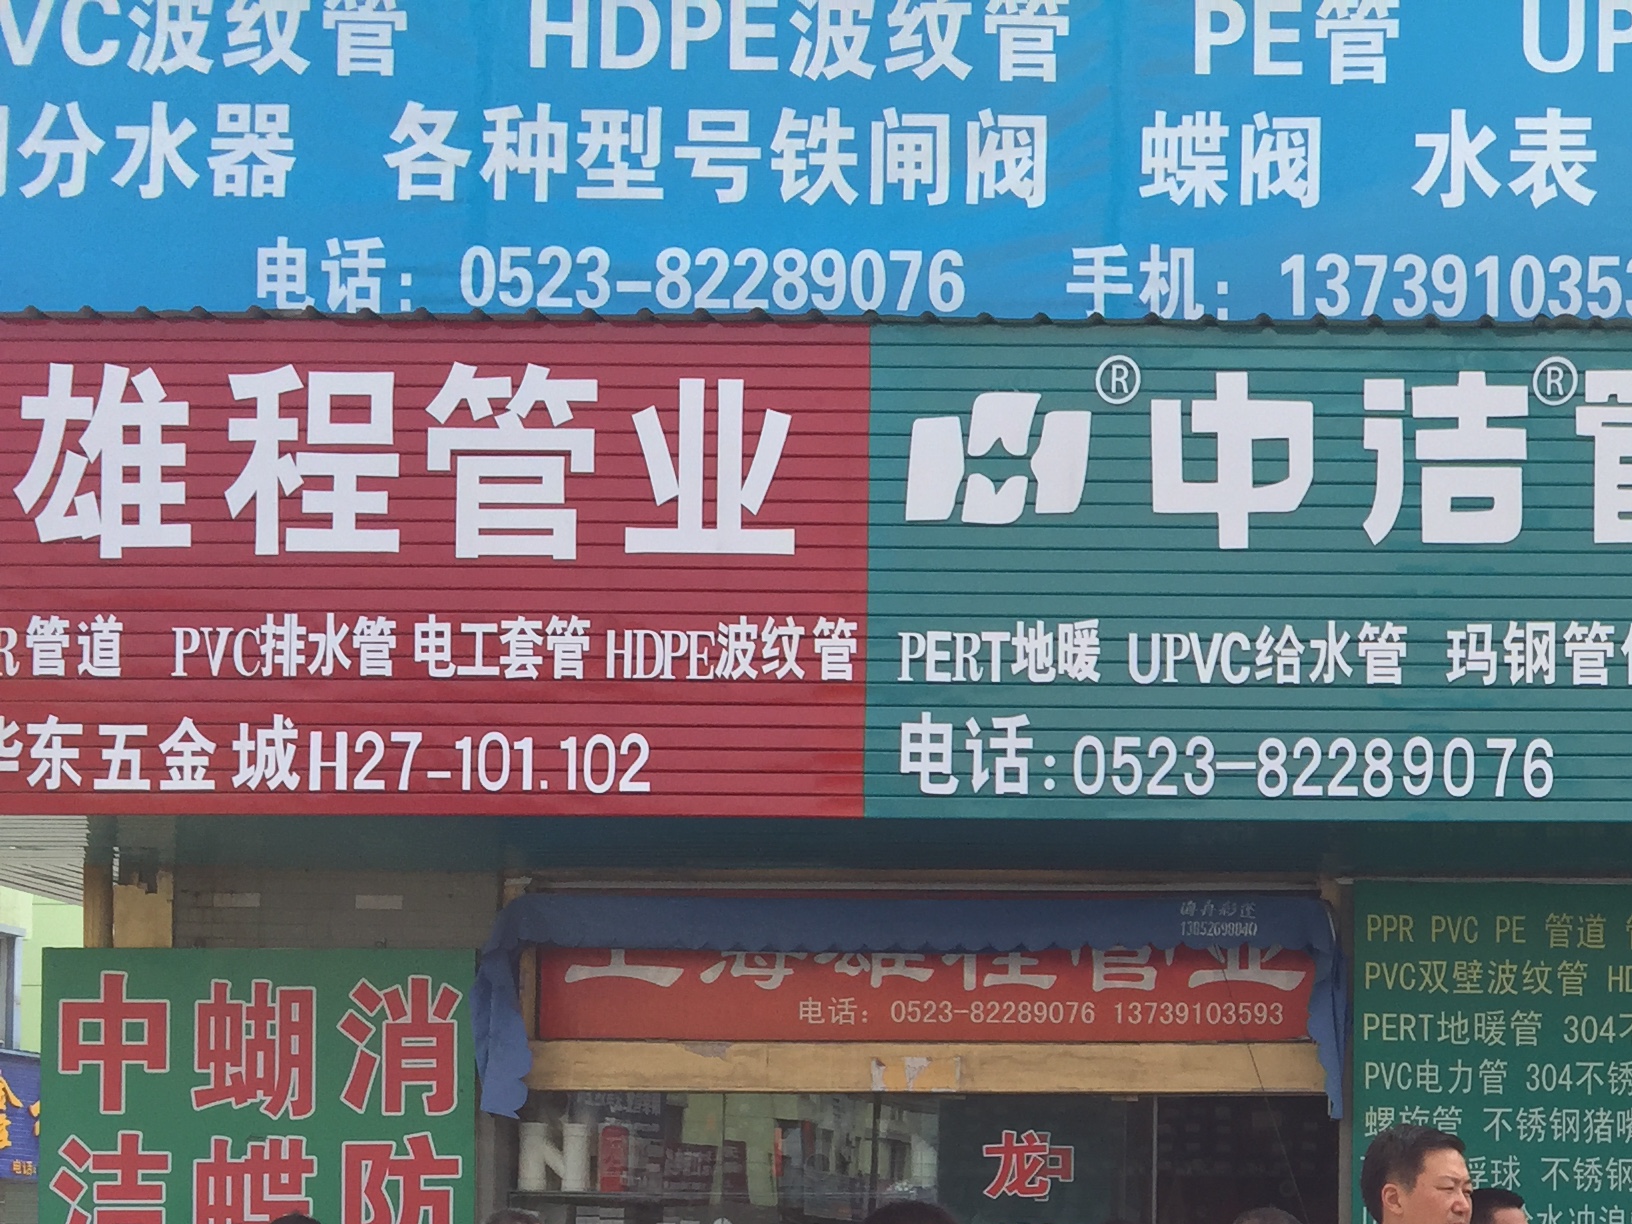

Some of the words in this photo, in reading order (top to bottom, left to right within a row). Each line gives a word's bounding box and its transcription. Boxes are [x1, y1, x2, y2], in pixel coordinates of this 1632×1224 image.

[0, 101, 297, 199] 分水器
[383, 101, 1048, 208] 各种型号铁闸阀
[1140, 111, 1320, 208] 蝶阀
[1412, 108, 1596, 208] 水表
[460, 246, 966, 312] 0523-82289076
[14, 362, 794, 559] 雄程管业
[172, 613, 396, 676] PVC排水管
[415, 614, 590, 679] 电工套管
[607, 616, 857, 680] HDPE波纹管
[898, 619, 1100, 682] PERT地暖
[1129, 621, 1407, 684] UPVC给水管
[1366, 914, 1414, 943] PPR
[1431, 915, 1479, 944] PVC
[1495, 915, 1527, 944] PE
[1545, 914, 1607, 950] 管道
[1364, 959, 1588, 997] PVC双壁波纹管
[890, 1000, 1096, 1025] 0523-82289076
[1114, 1001, 1284, 1026] 13739103593
[1363, 1010, 1543, 1047] PERT地暖管
[1364, 1058, 1508, 1096] PVC电力管
